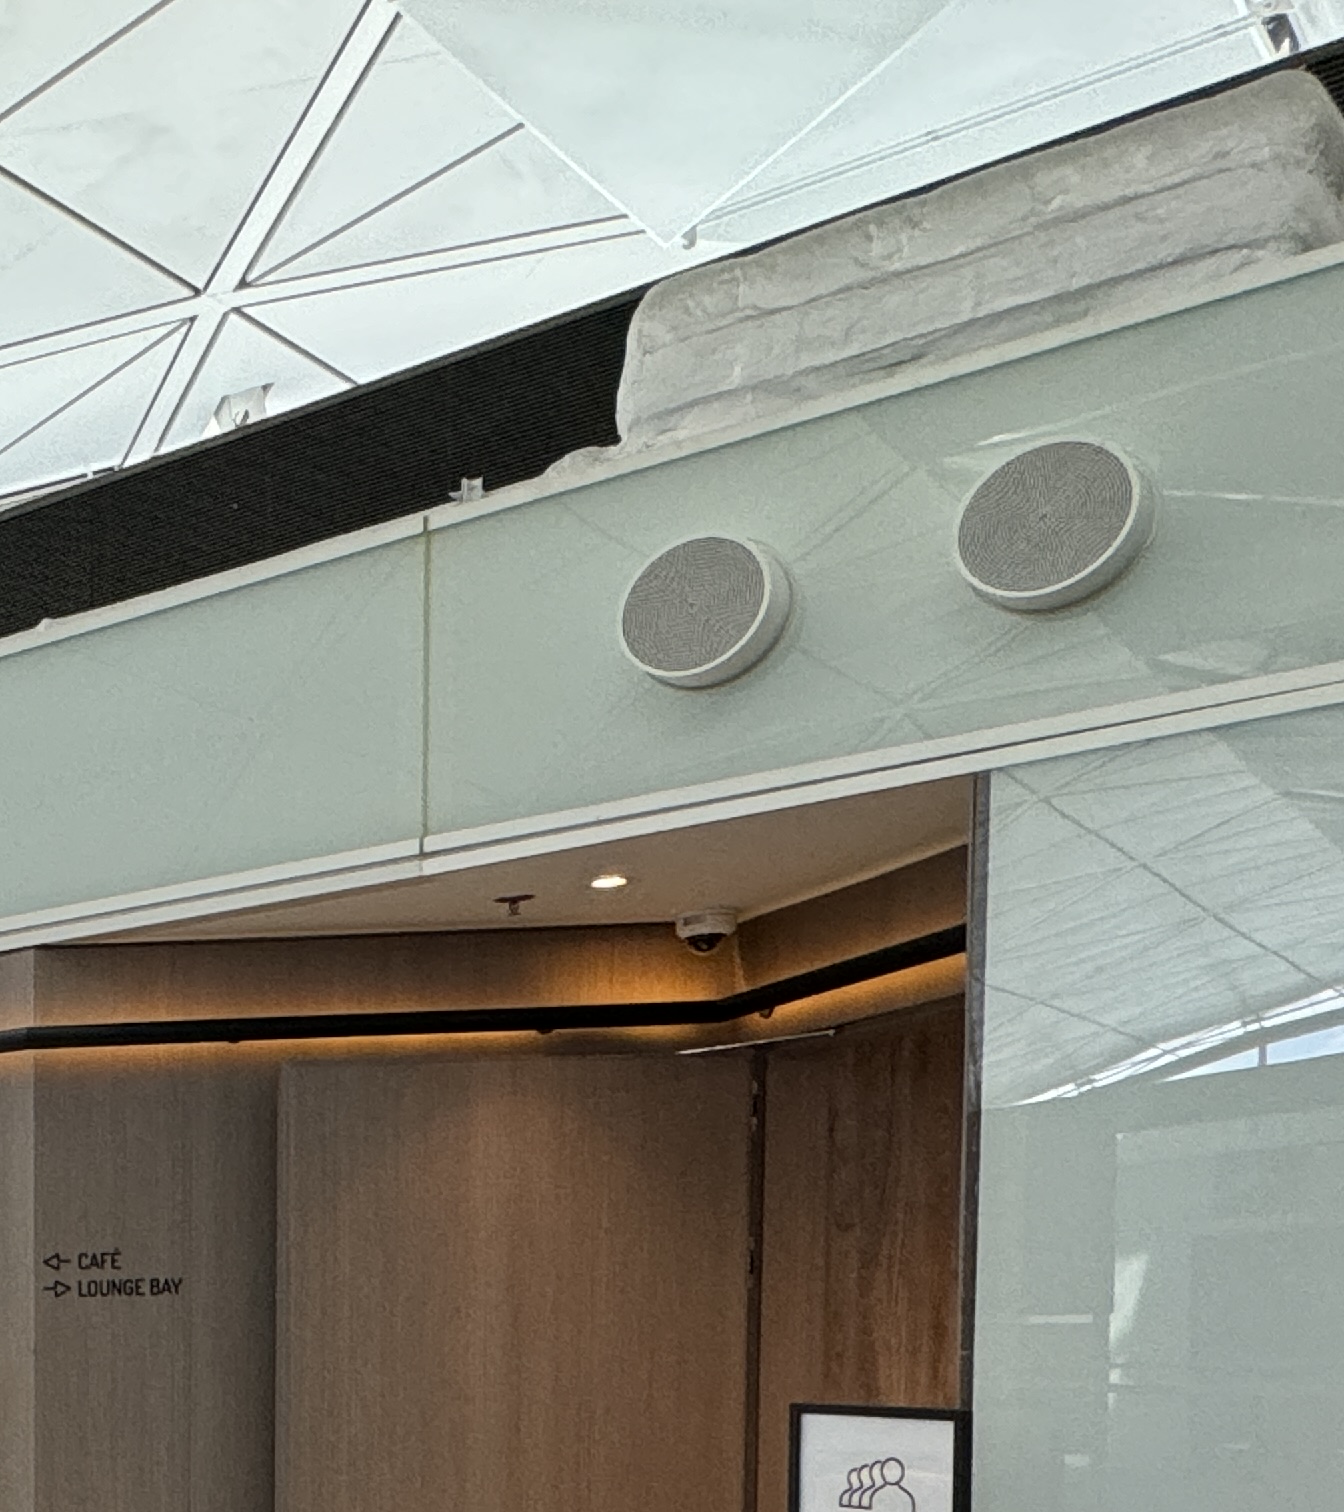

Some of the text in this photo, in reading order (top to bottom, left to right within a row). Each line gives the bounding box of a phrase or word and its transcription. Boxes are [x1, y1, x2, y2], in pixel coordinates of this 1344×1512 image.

[78, 1247, 121, 1270] CAFÉ
[78, 1277, 183, 1297] LOUNGE BAY
